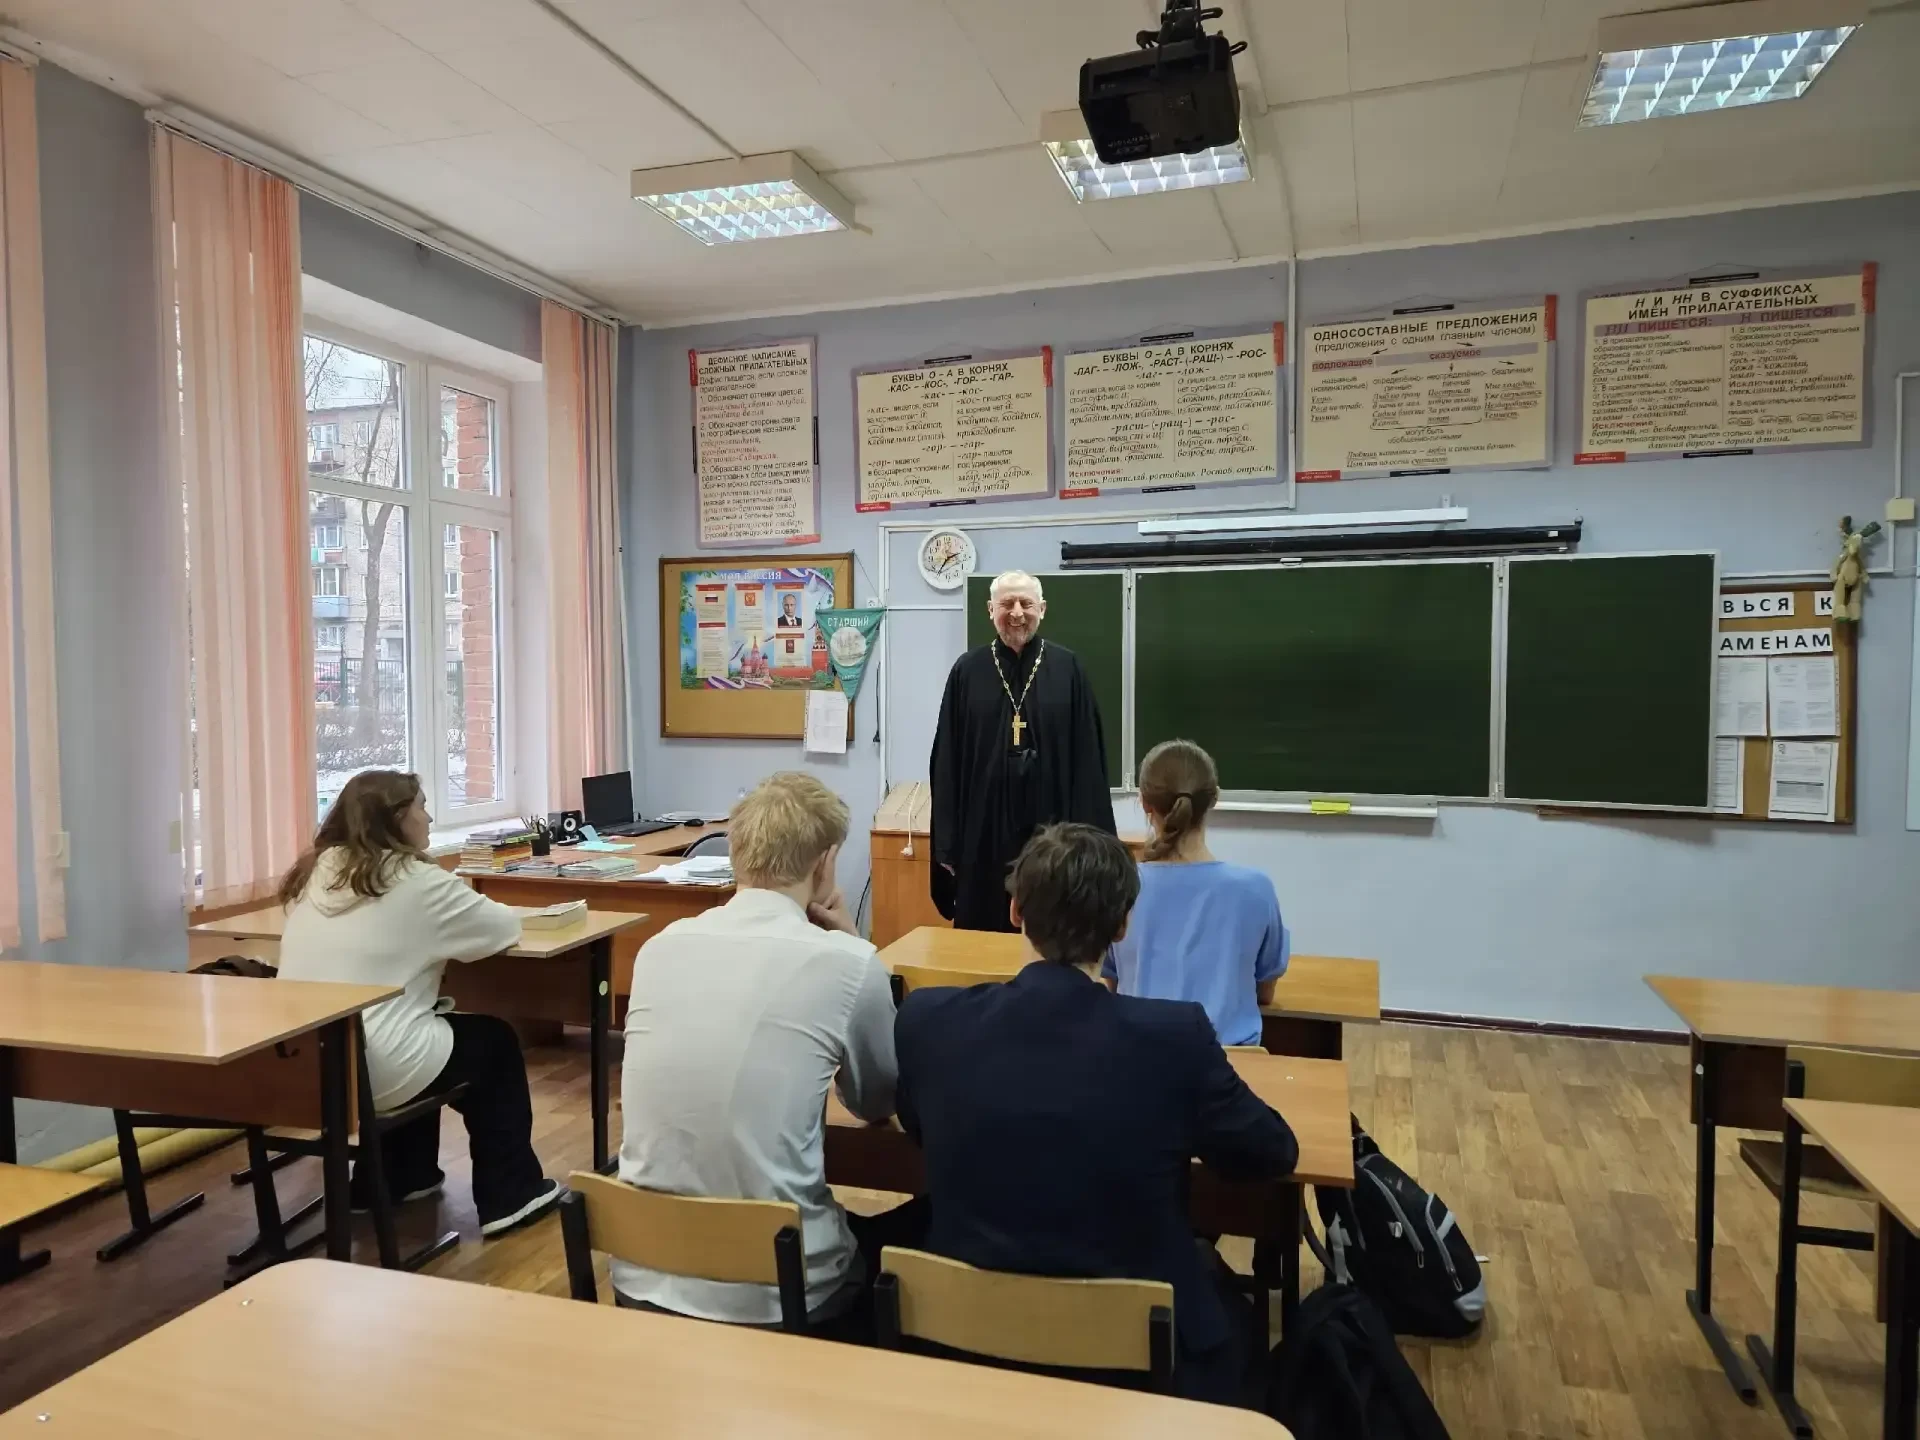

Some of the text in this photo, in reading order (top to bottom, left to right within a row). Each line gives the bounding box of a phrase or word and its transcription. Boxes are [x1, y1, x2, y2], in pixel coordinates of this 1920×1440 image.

[1634, 283, 1812, 309] Н И НН В СУФФИКСАХ
[1679, 295, 1818, 316] ПРИЛАГАТЕЛЬНЫХ
[1313, 322, 1428, 341] ОДНОСОСТАВНЫЕ
[1437, 313, 1538, 330] ПРЕДЛОЖЕНИЯ
[1638, 318, 1712, 332] ПИШЕТСЯ:
[1315, 338, 1384, 352] (предложения
[1402, 335, 1434, 345] одним
[1441, 331, 1485, 341] главным
[1491, 326, 1536, 337] членом)
[708, 350, 796, 365] ДЕФИСНОЕ НАПИСАНИЕ
[1074, 349, 1266, 376] -ЛАГ- -ЛОЖ-, -РАСТ- (-РАЩ-) -РОС-
[1103, 352, 1139, 364] БУКВЫ
[1165, 349, 1172, 357] А
[1190, 342, 1234, 354] КОРНЯХ
[1312, 350, 1481, 371] подлежащее сказуемое
[699, 358, 807, 375] СЛОЖНЫХ ПРИЛАГАТЕЛЬНЫХ
[892, 374, 924, 384] БУКВЫ
[929, 371, 936, 379] О
[958, 368, 964, 376] В
[970, 363, 1008, 374] КОРНЯХ
[888, 373, 1014, 393] -КАС- -КОС-, -ГОР- -ГАР-
[921, 388, 983, 400] -кас- -кос-
[1112, 423, 1149, 434] -раст-
[1207, 417, 1235, 427] -рос-
[1069, 469, 1123, 478] Исключения:
[1723, 597, 1832, 613] ВЬСЯ К
[828, 616, 869, 626] СТАРШИЙ
[1721, 633, 1830, 651] АМЕНАМ
